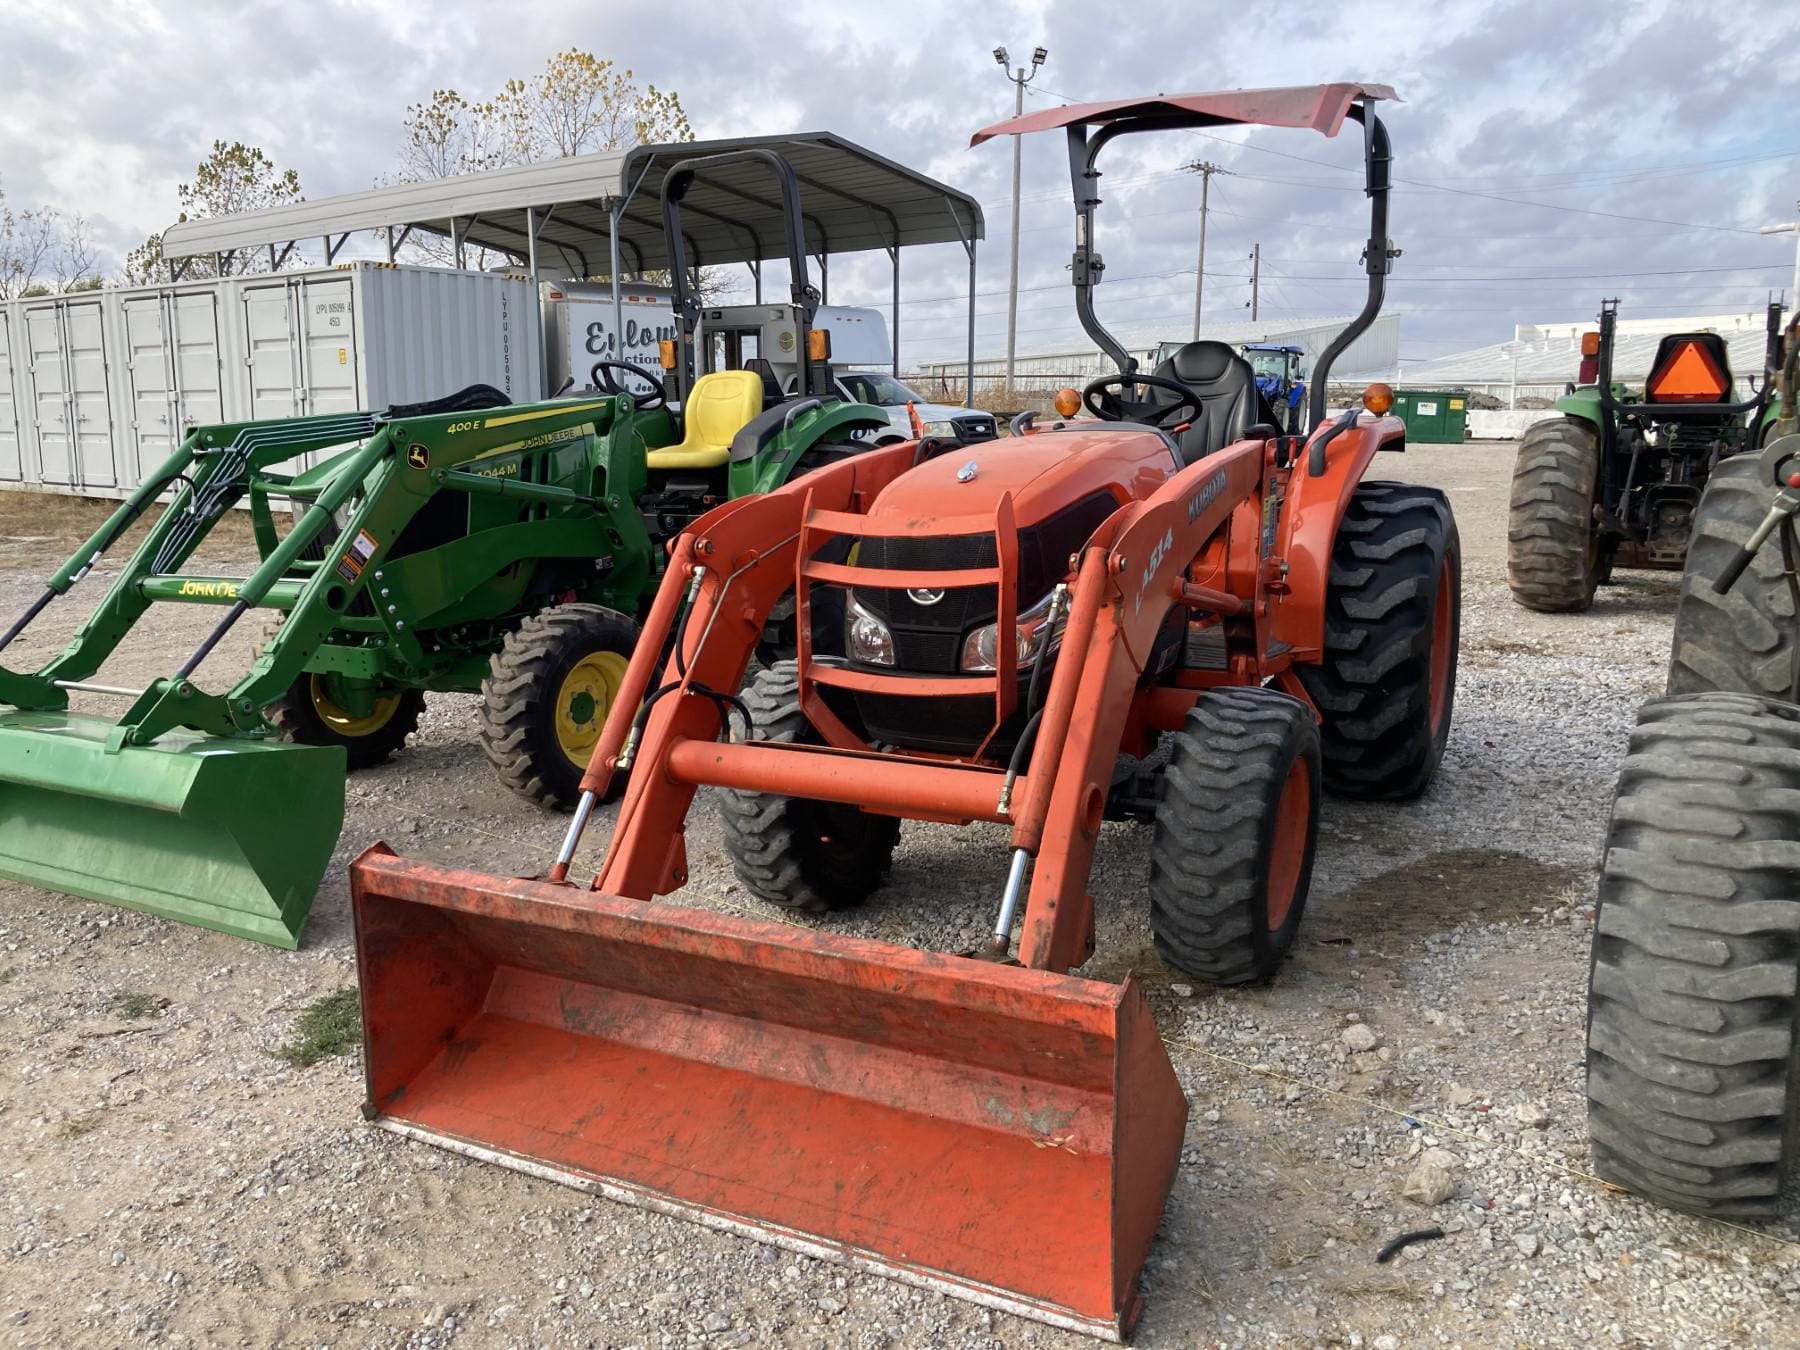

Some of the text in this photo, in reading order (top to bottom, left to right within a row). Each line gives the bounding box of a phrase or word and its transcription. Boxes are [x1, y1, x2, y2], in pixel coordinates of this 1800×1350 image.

[521, 429, 576, 451] JOHN DEERE
[1188, 469, 1227, 525] KUBOTA
[178, 579, 216, 596] JOHN
